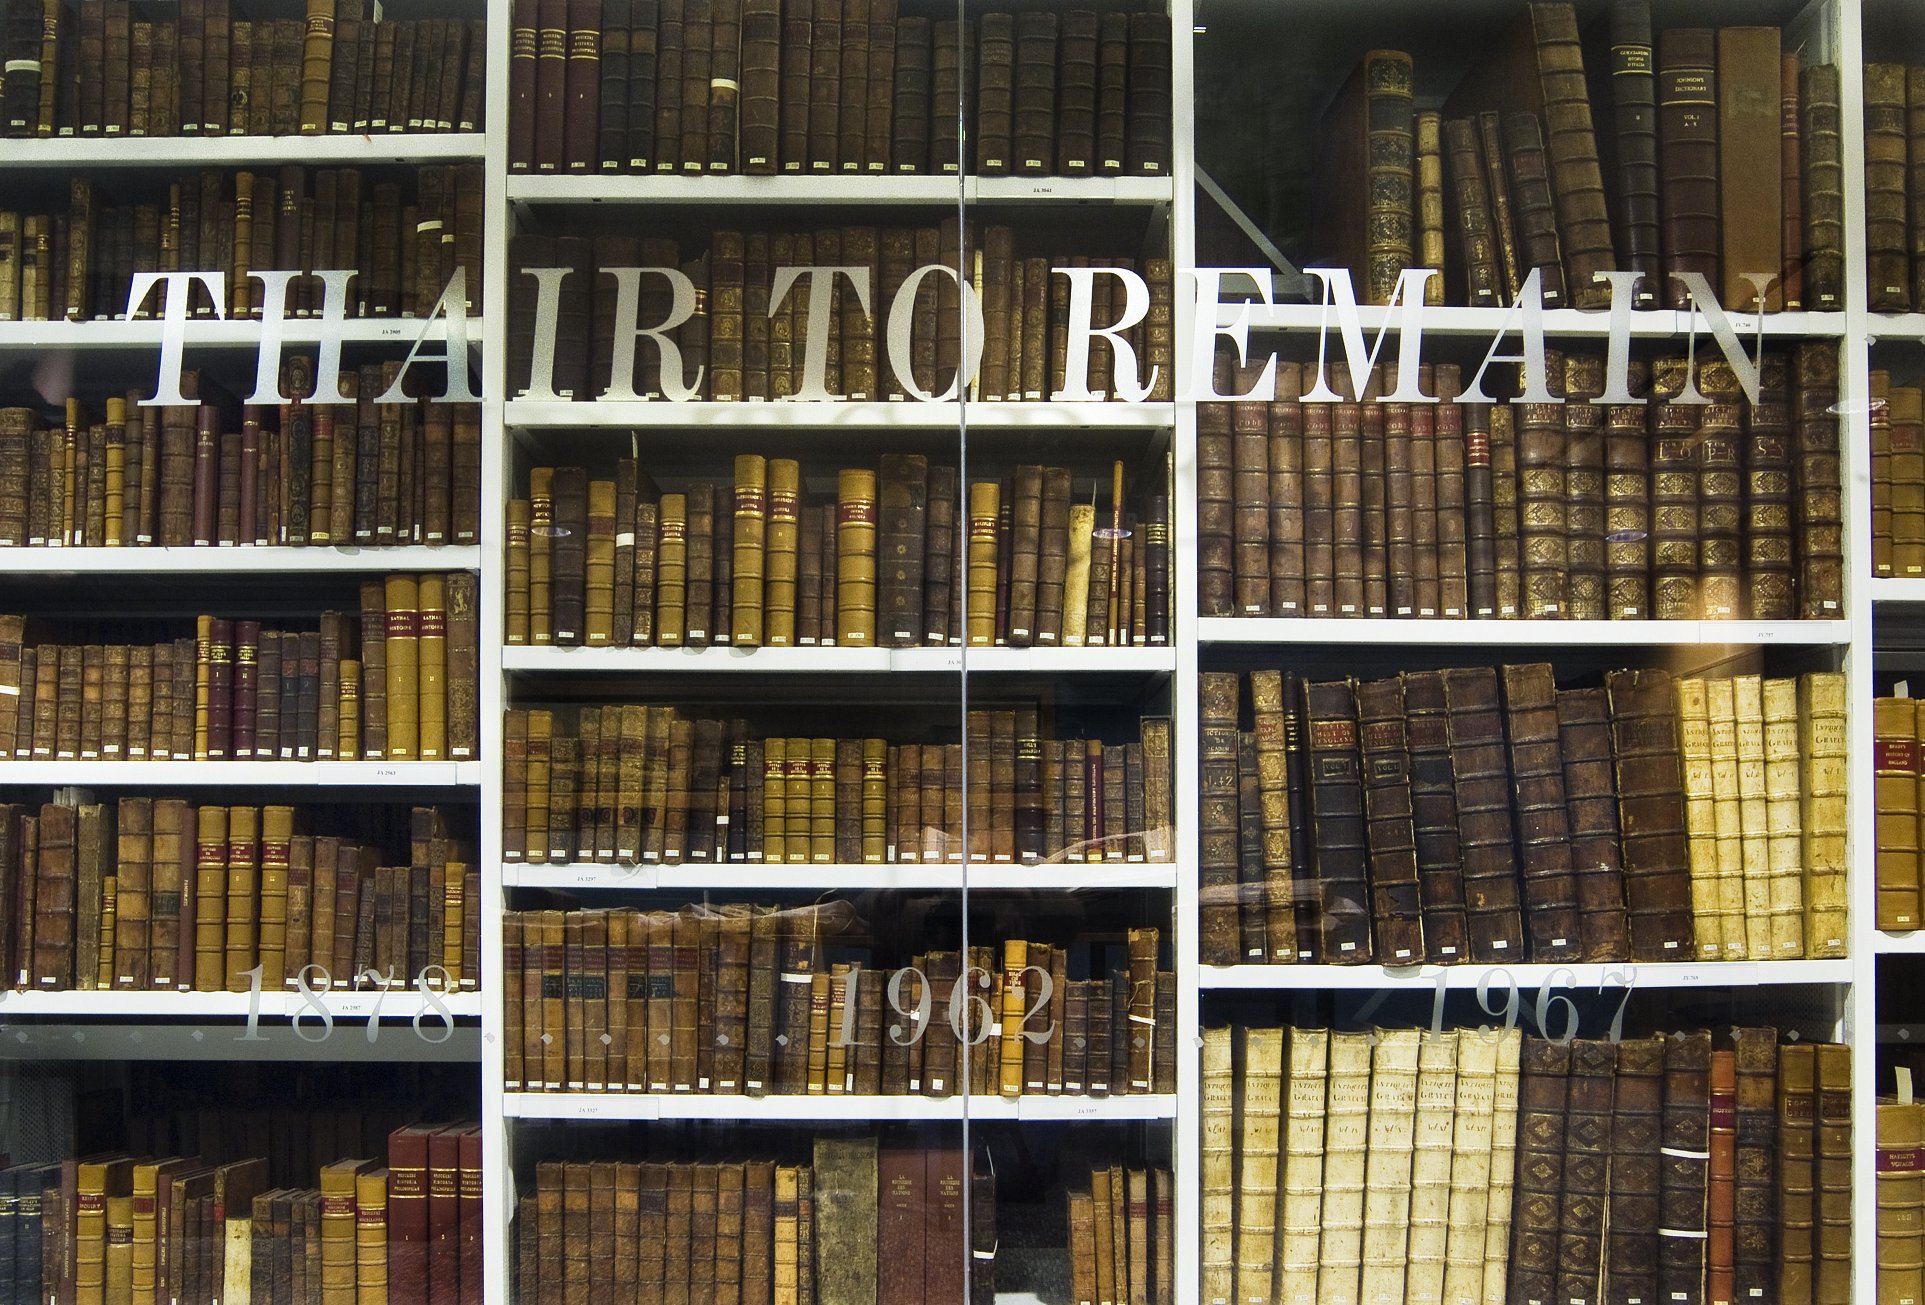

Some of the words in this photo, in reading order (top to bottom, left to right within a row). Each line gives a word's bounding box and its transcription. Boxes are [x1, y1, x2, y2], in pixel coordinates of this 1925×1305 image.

[768, 265, 985, 403] TO
[1050, 267, 1780, 406] REMAIN
[233, 964, 455, 1044] 1878
[827, 965, 1056, 1047] 1962
[1418, 967, 1638, 1046] 1967
